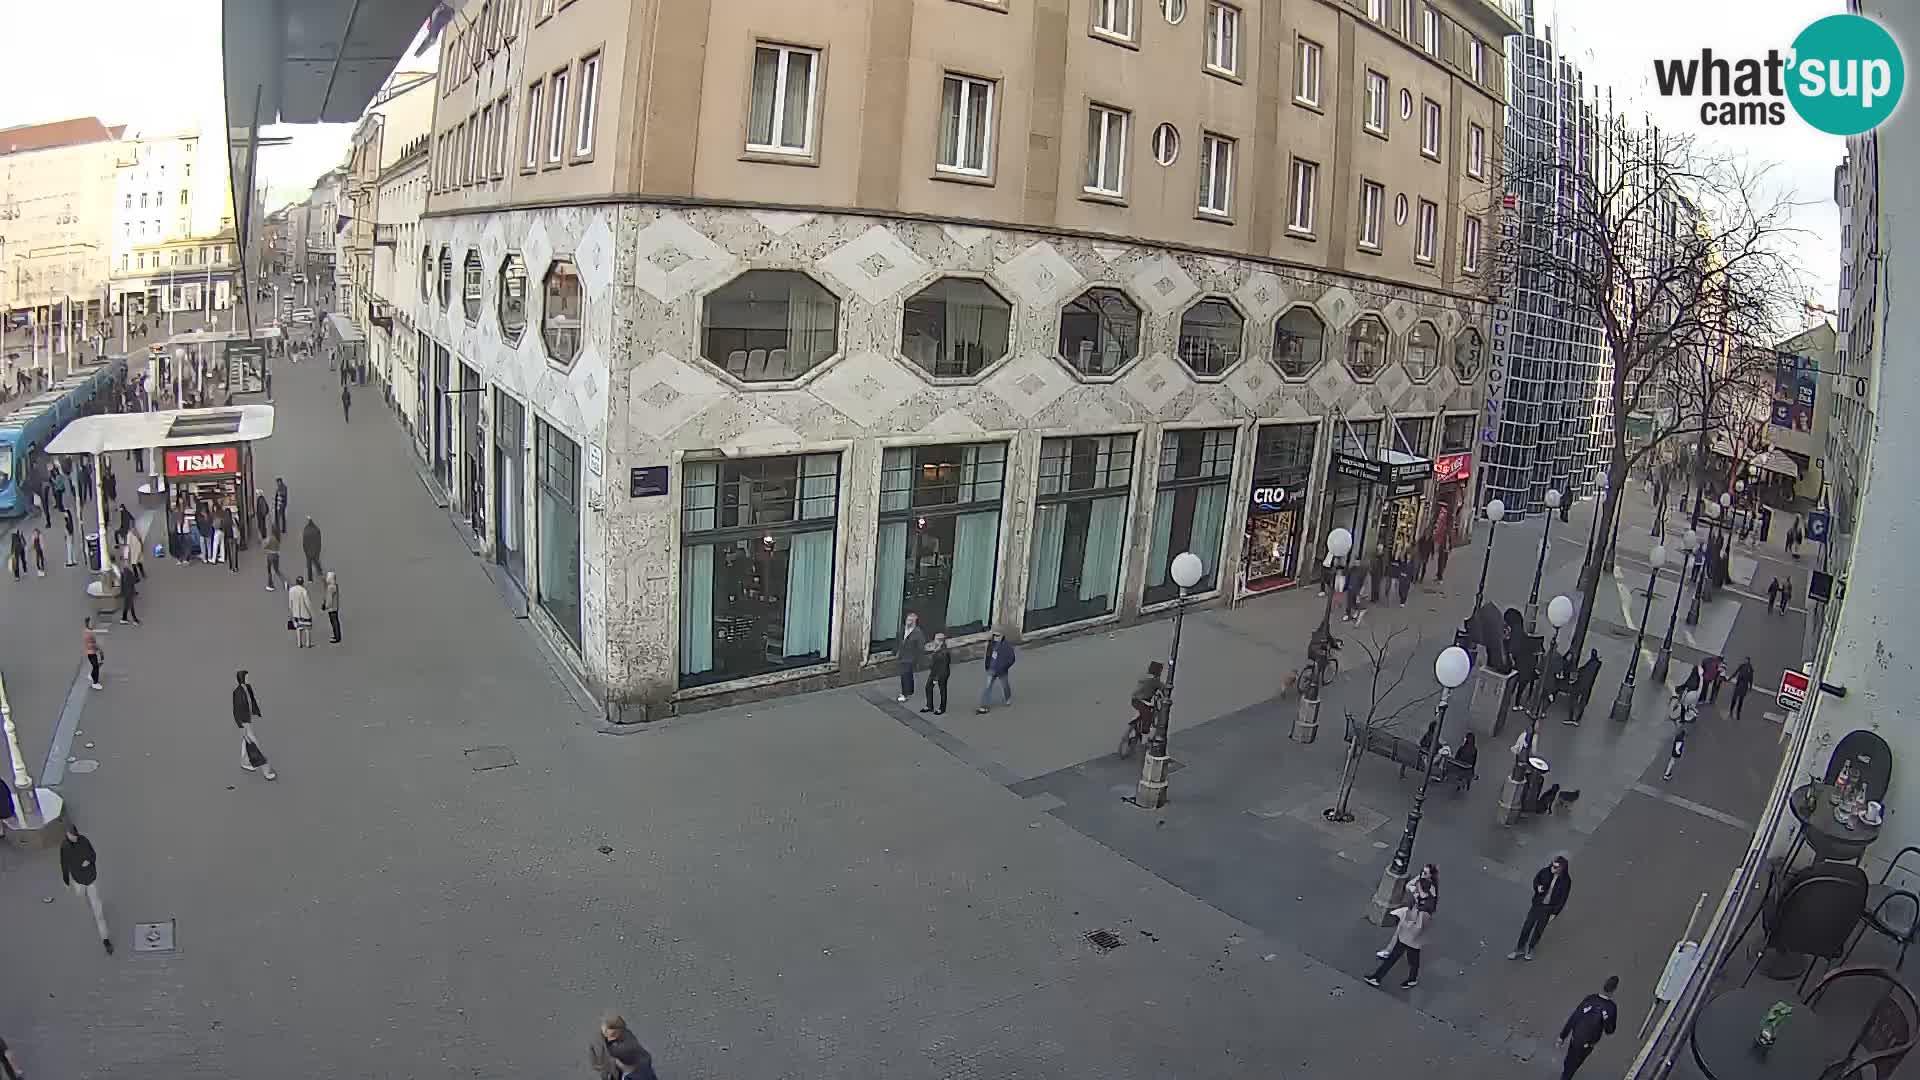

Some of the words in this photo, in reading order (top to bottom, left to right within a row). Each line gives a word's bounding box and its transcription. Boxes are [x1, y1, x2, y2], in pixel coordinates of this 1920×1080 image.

[1482, 308, 1509, 442] DUBROVNIK
[176, 453, 225, 472] TISAK
[1253, 488, 1285, 503] CRO
